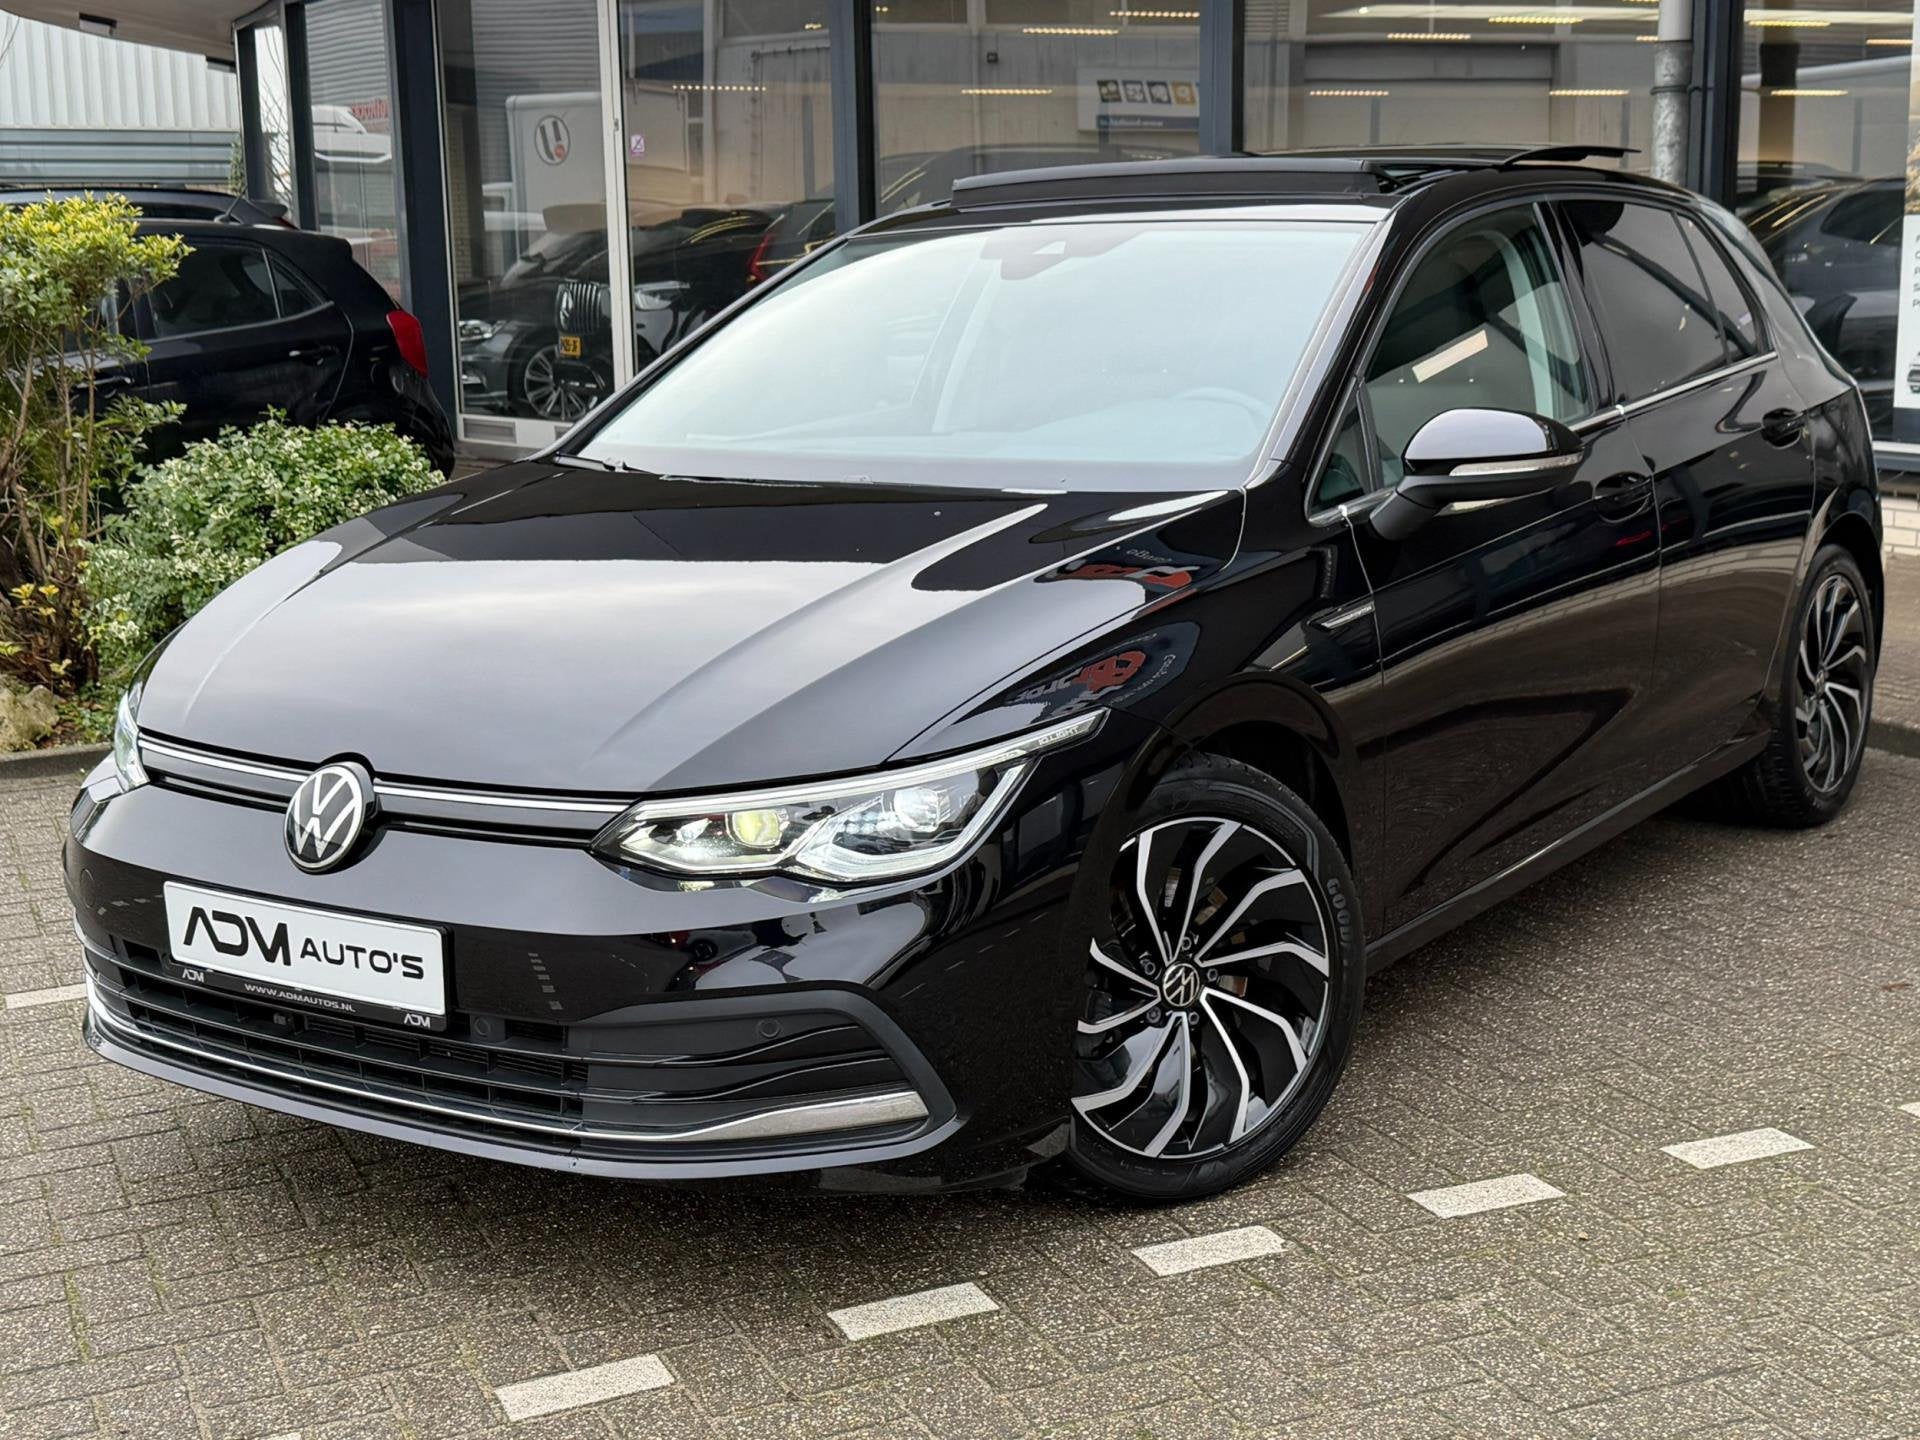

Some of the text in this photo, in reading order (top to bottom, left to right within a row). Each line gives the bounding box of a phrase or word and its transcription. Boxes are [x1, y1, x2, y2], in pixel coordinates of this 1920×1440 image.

[183, 905, 424, 980] ADM AUTO'S
[244, 983, 357, 1013] WWW.ADMAUTOS.NL
